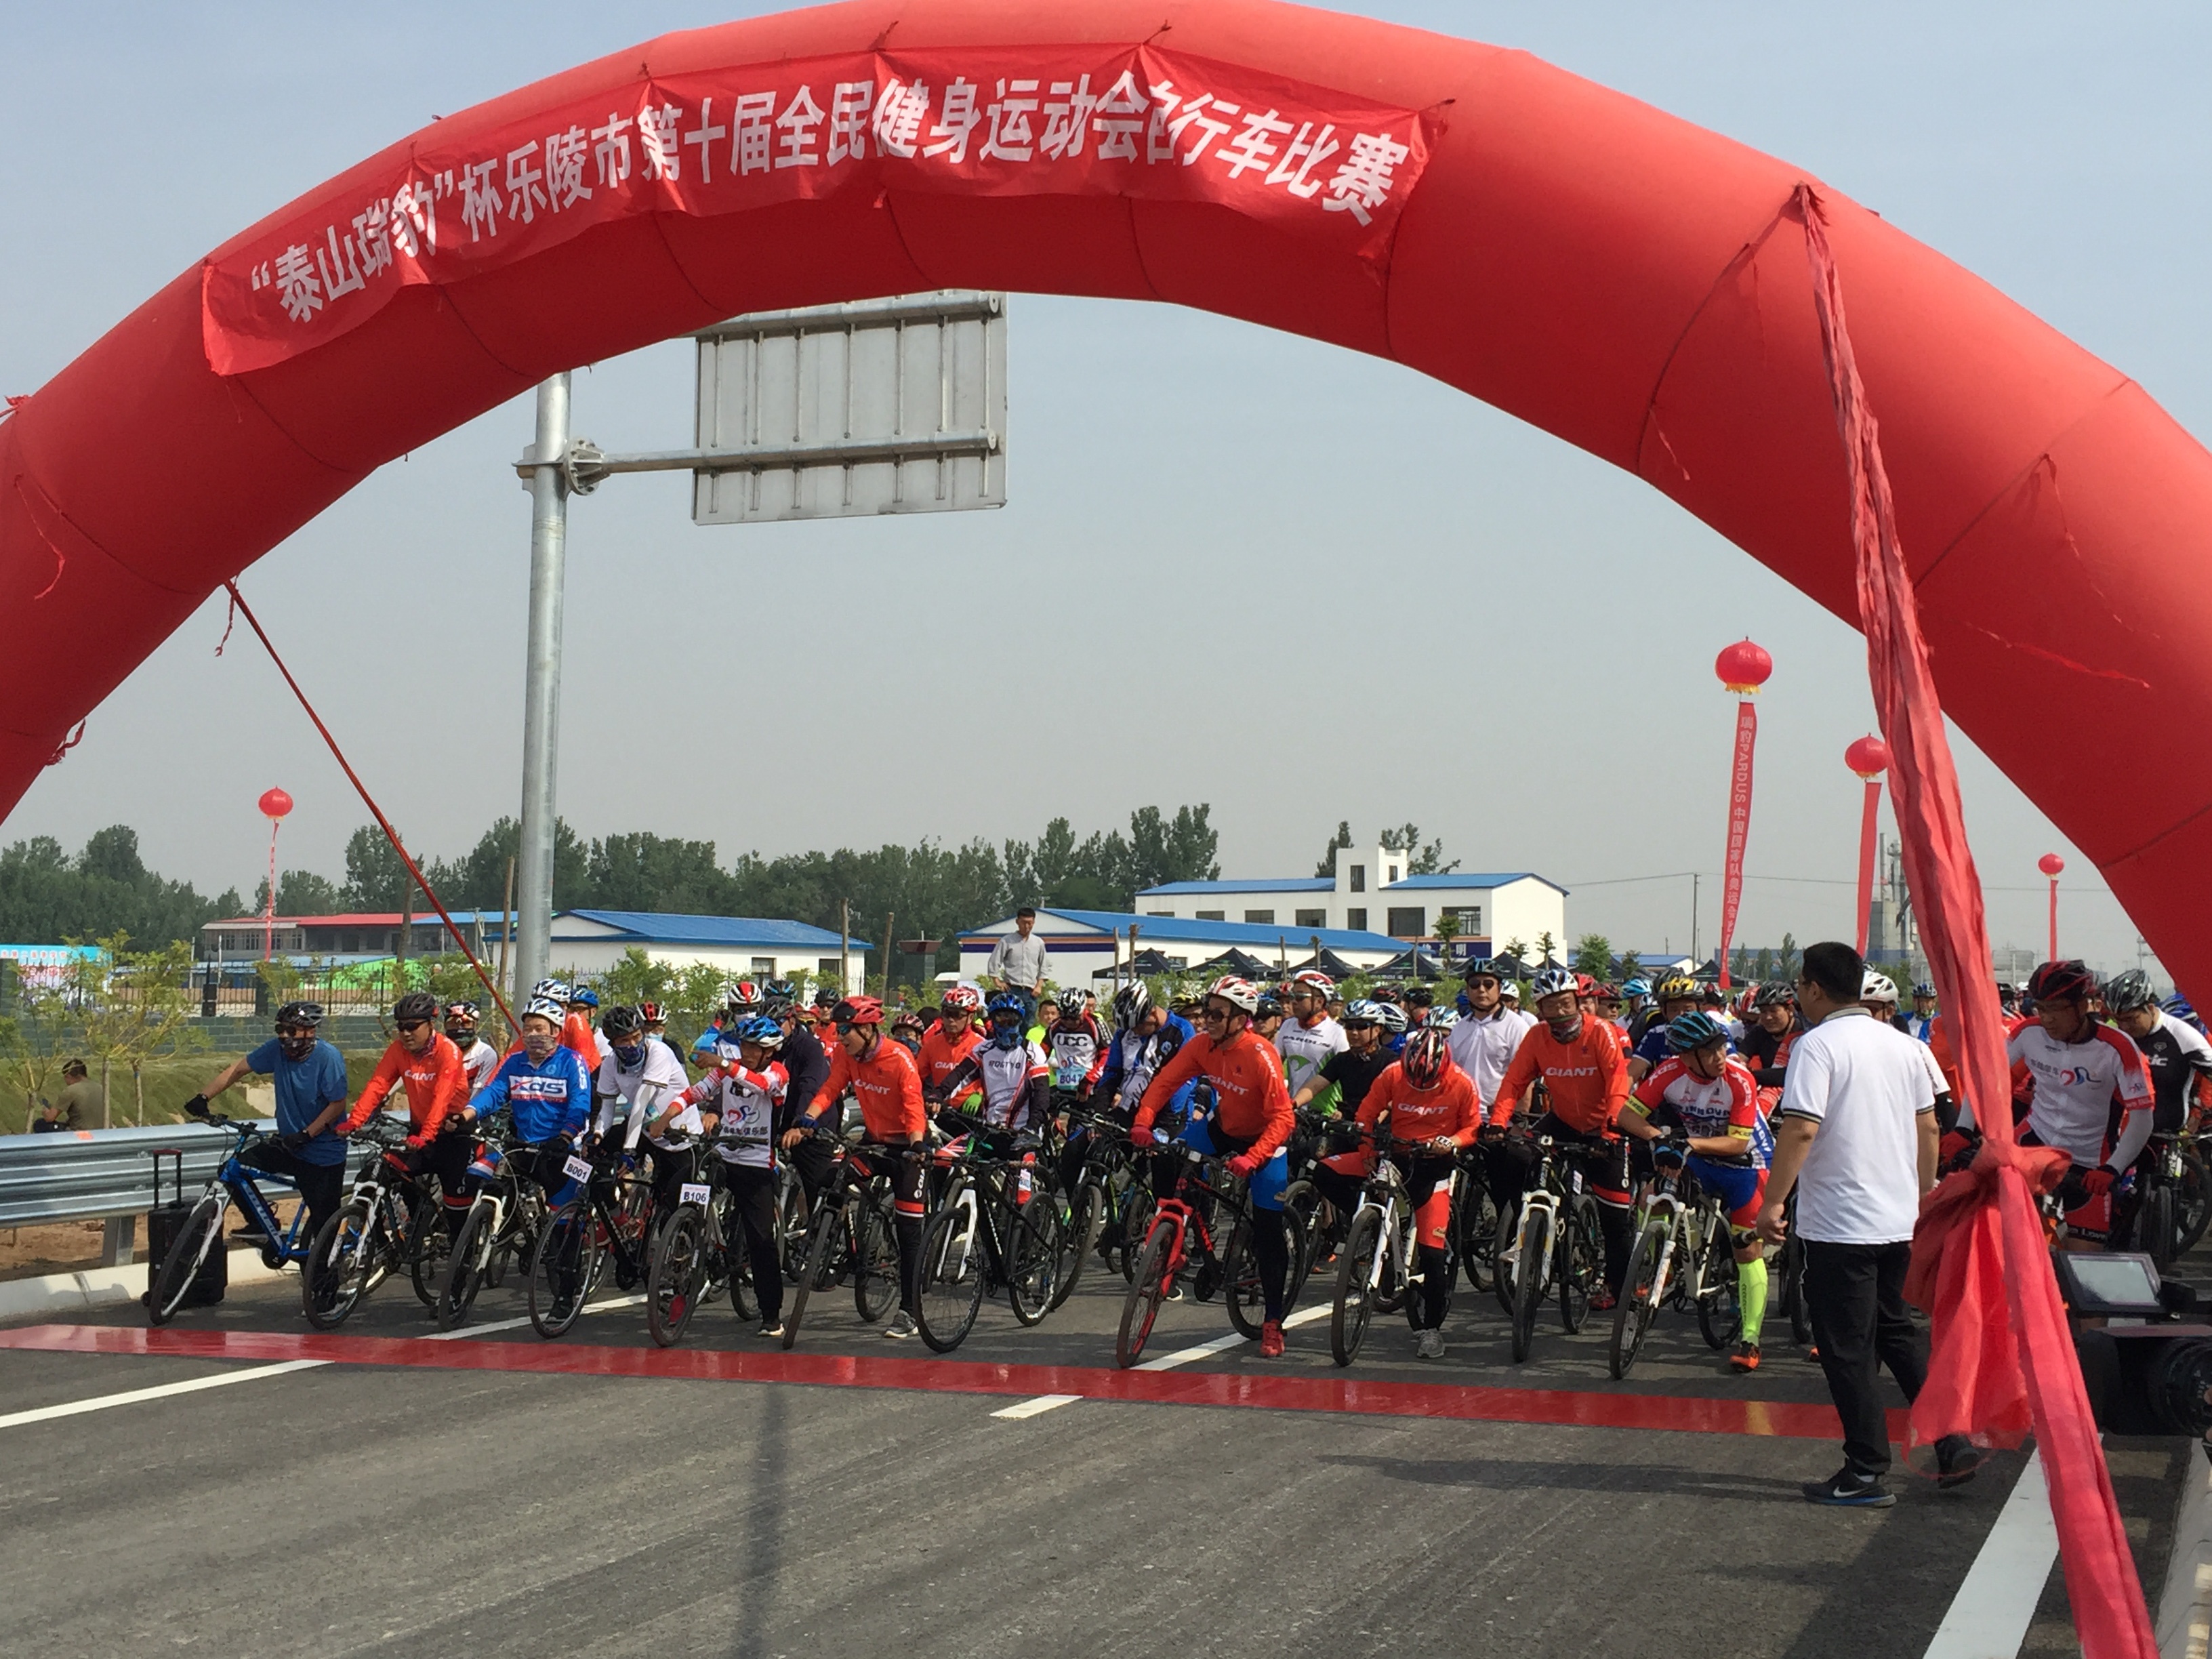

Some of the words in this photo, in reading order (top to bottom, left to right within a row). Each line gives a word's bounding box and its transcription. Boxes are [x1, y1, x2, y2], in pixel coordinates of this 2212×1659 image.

[1057, 1035, 1088, 1047] UCC
[404, 1069, 436, 1082] GANT
[1545, 1067, 1598, 1077] GIANT
[1208, 1074, 1249, 1096] GIANT
[1397, 1103, 1449, 1115] GIANT
[567, 1162, 588, 1180] B001
[684, 1191, 707, 1202] B106
